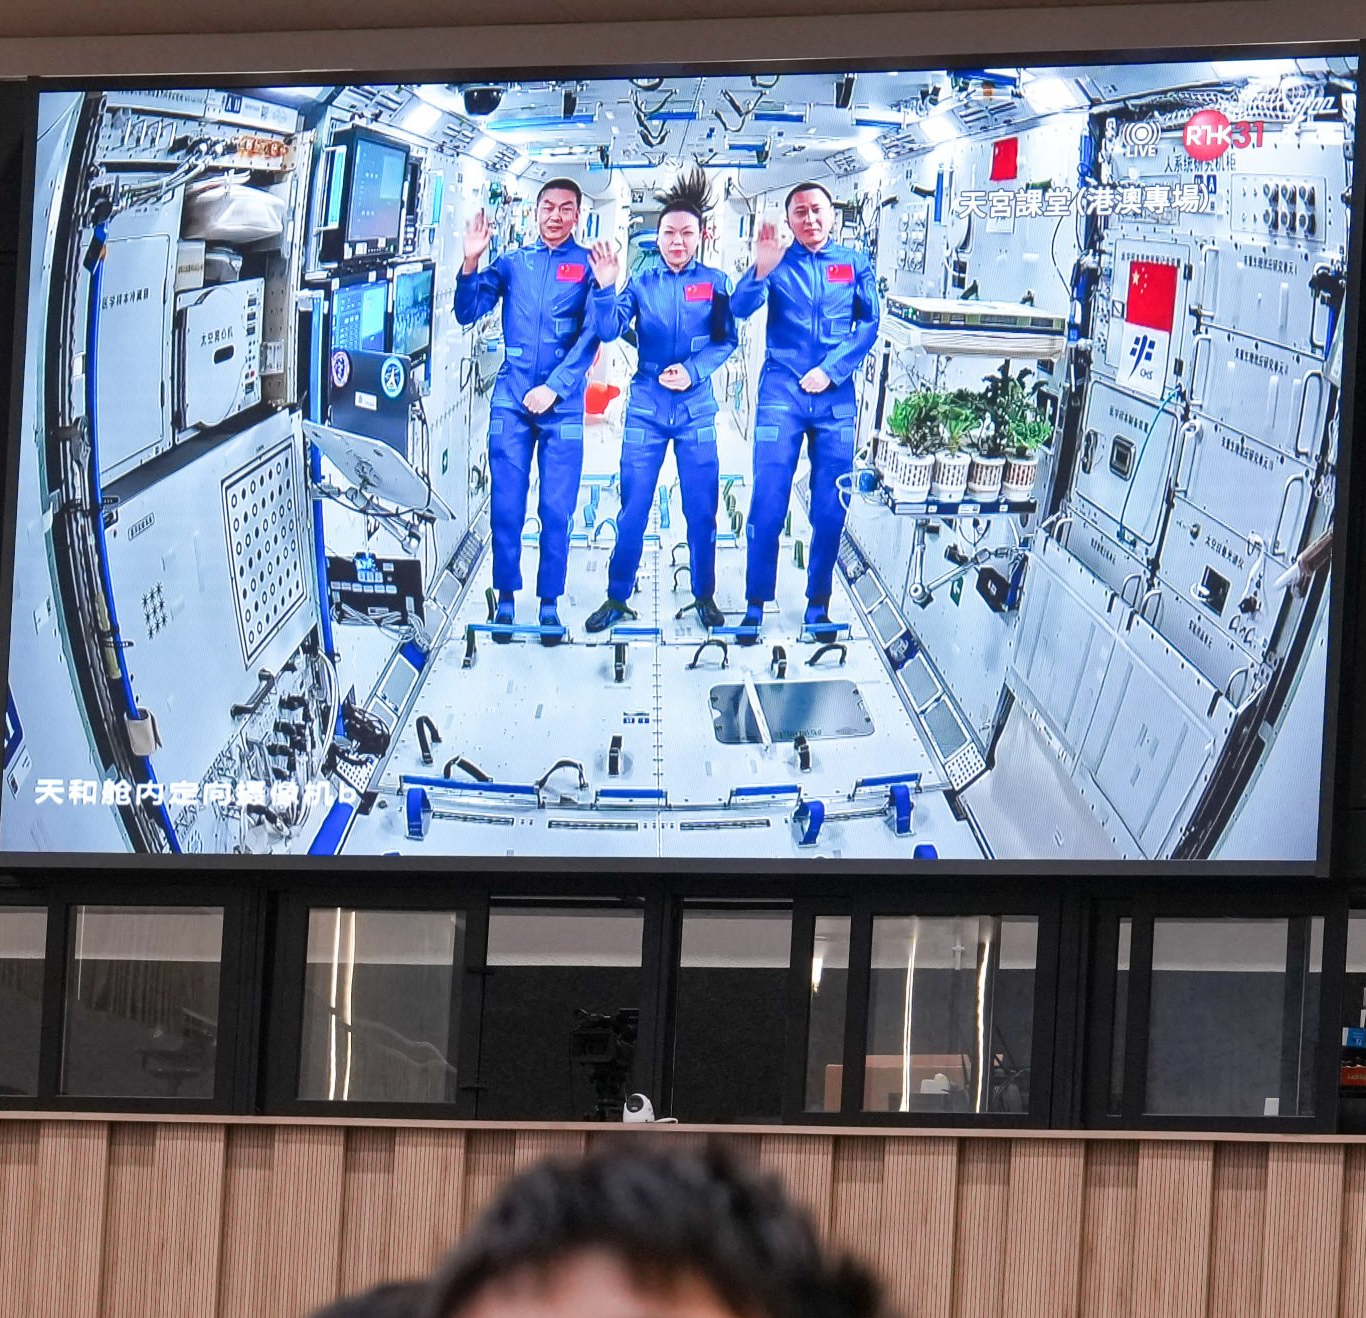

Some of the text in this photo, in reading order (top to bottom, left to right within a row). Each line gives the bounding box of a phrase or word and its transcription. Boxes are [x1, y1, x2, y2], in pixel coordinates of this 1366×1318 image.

[1186, 120, 1264, 149] RTHK 31
[1126, 145, 1156, 158] LIVE
[958, 182, 1210, 219] 天宮課堂(港澳專場)
